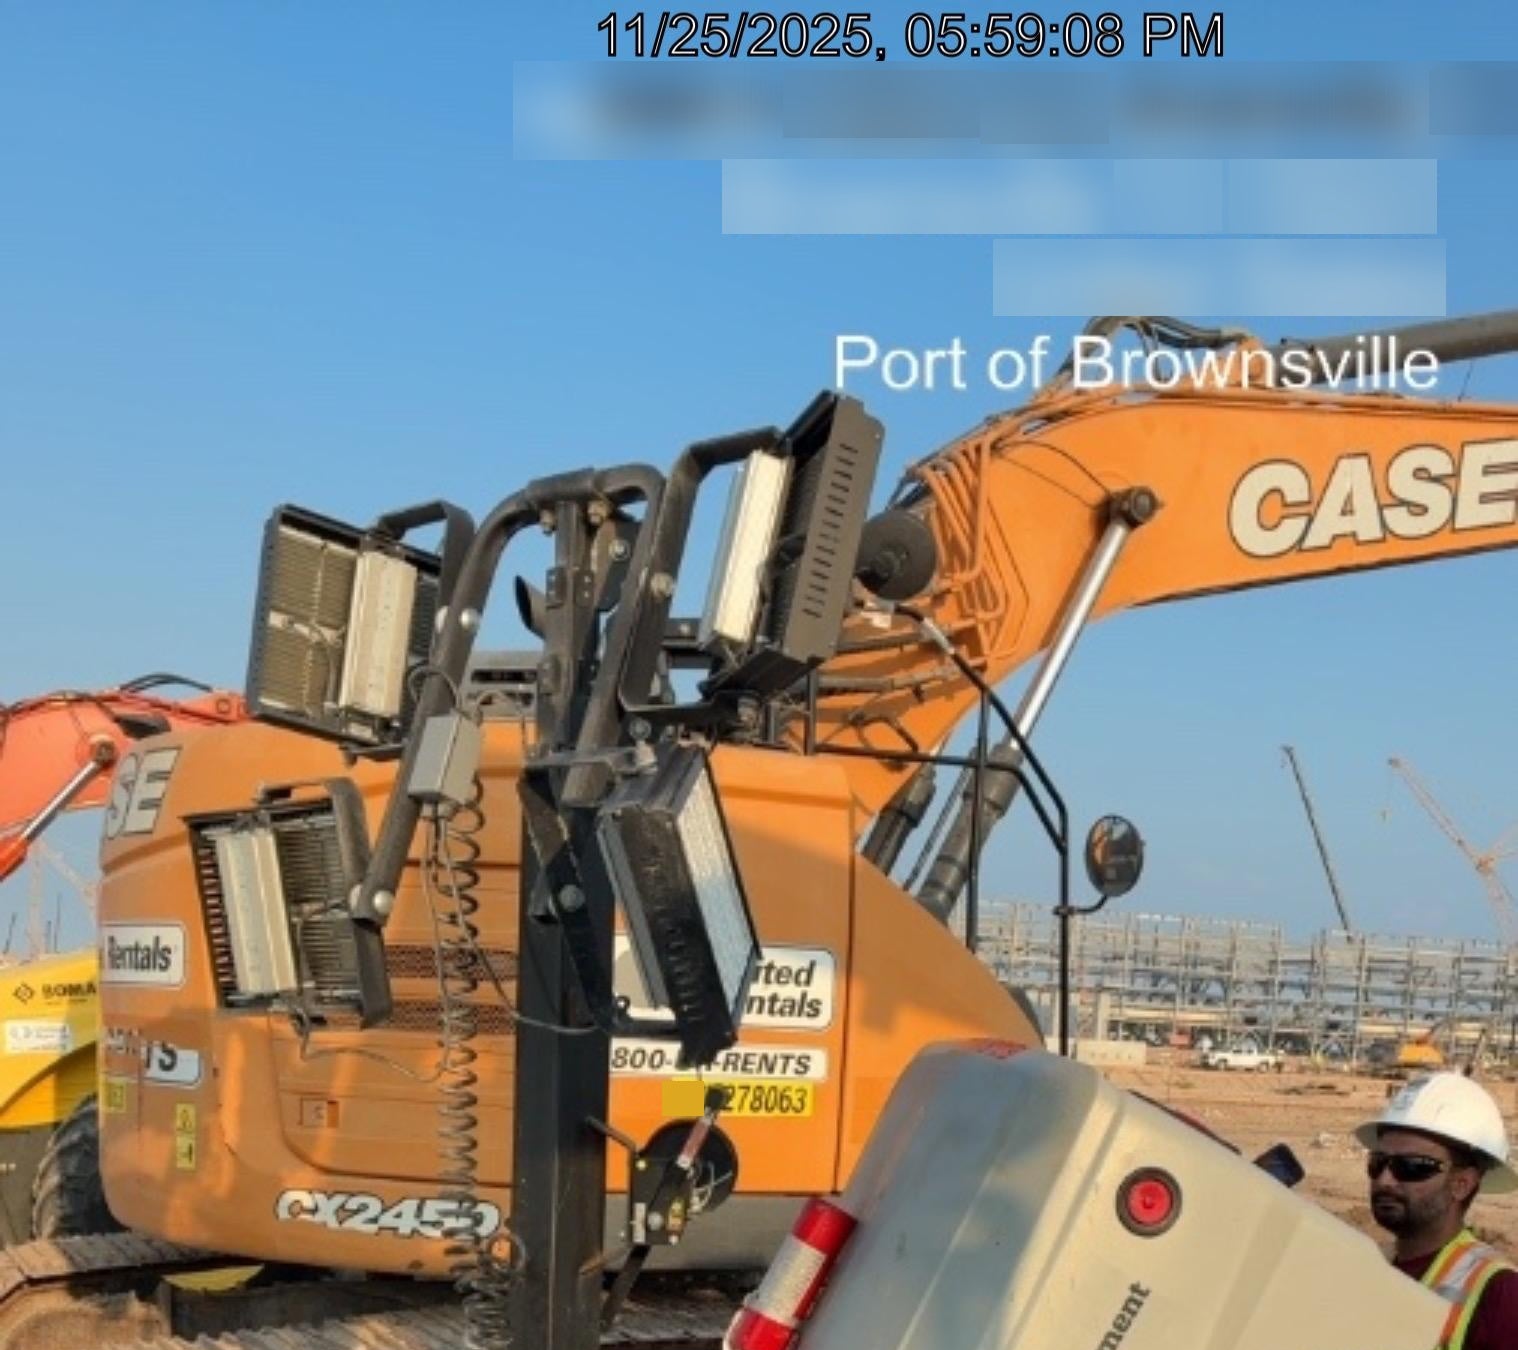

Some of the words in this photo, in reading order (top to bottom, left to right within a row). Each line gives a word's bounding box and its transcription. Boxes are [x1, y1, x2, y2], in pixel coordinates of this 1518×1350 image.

[1227, 435, 1518, 559] CASE
[106, 746, 183, 840] SE
[753, 959, 816, 987] ited
[41, 981, 97, 998] BOMA
[745, 991, 823, 1019] ntals
[720, 1084, 808, 1115] 278063
